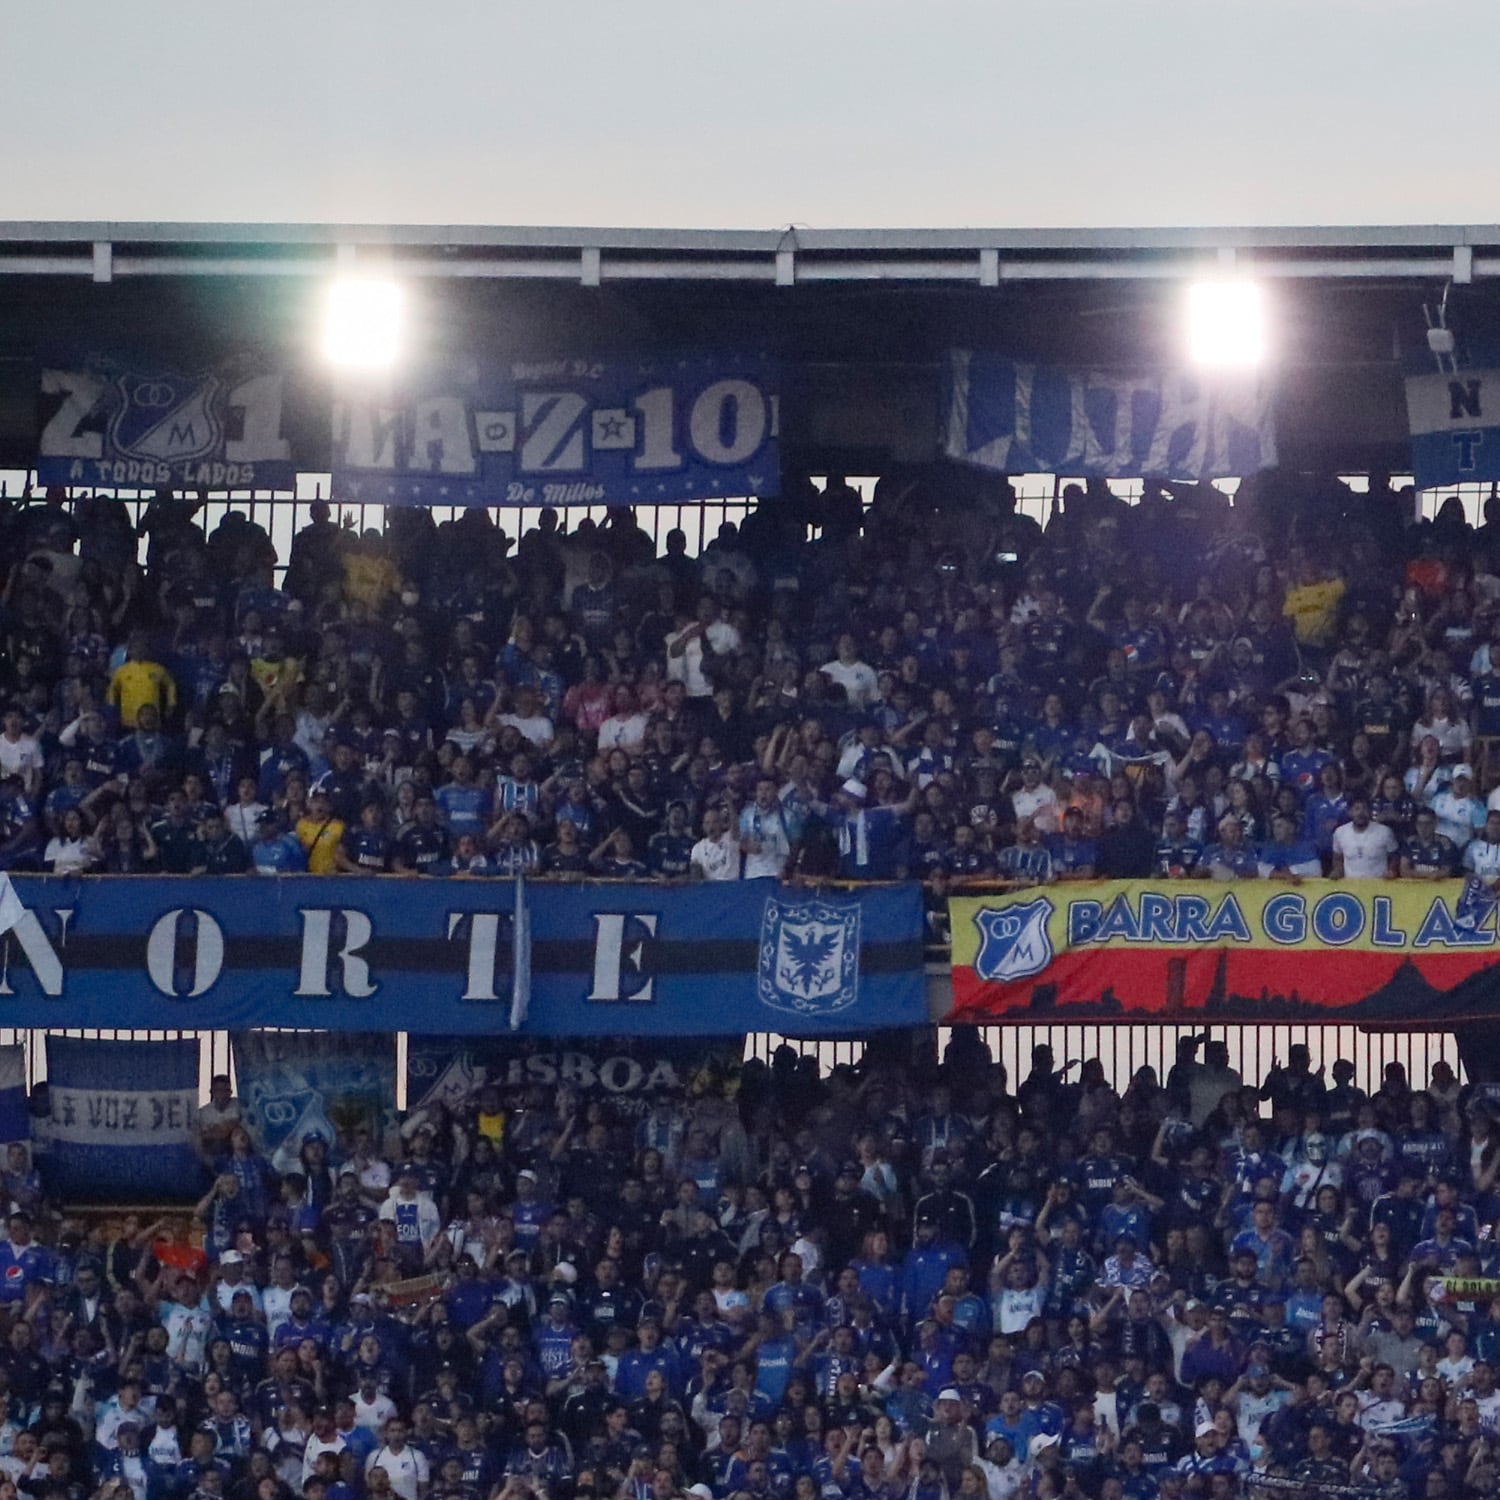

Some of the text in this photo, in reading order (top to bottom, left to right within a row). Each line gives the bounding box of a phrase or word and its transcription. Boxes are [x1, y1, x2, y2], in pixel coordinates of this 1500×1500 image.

[1449, 379, 1483, 418] N
[634, 380, 766, 470] 10
[1451, 431, 1484, 471] T
[99, 461, 171, 483] TODOS
[183, 463, 254, 486] LADOS
[506, 483, 605, 503] De Millos
[1067, 892, 1251, 945] BARRA
[0, 908, 658, 999] NORTE
[1014, 942, 1035, 962] M
[88, 1093, 138, 1131] VOZ
